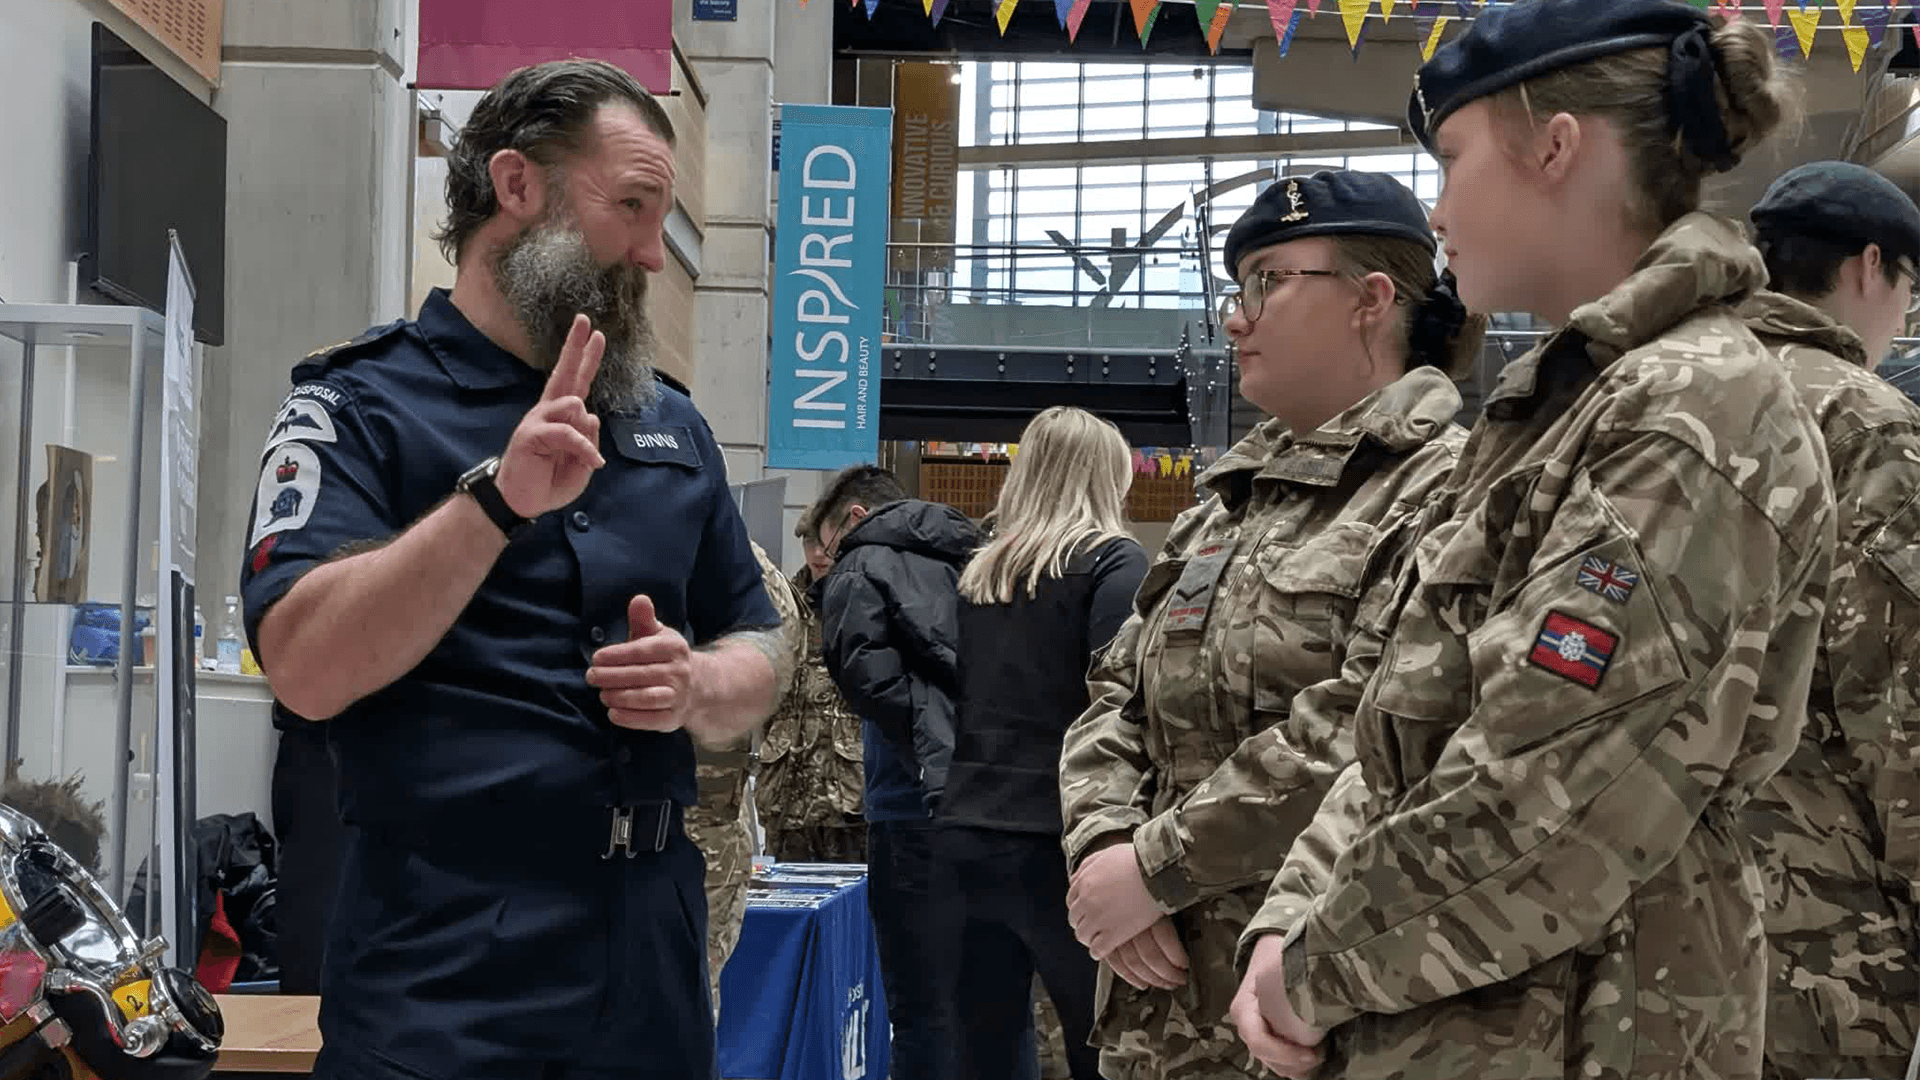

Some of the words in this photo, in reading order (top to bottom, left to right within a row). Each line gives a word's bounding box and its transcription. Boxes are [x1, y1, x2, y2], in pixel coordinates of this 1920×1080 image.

[929, 120, 952, 200] CURIOUS
[788, 145, 860, 429] INSPIRED
[859, 336, 869, 377] BEAUTY
[293, 385, 341, 406] DISPOSAL
[858, 379, 868, 403] AND
[857, 404, 867, 429] HAIR
[633, 433, 679, 449] BINNS
